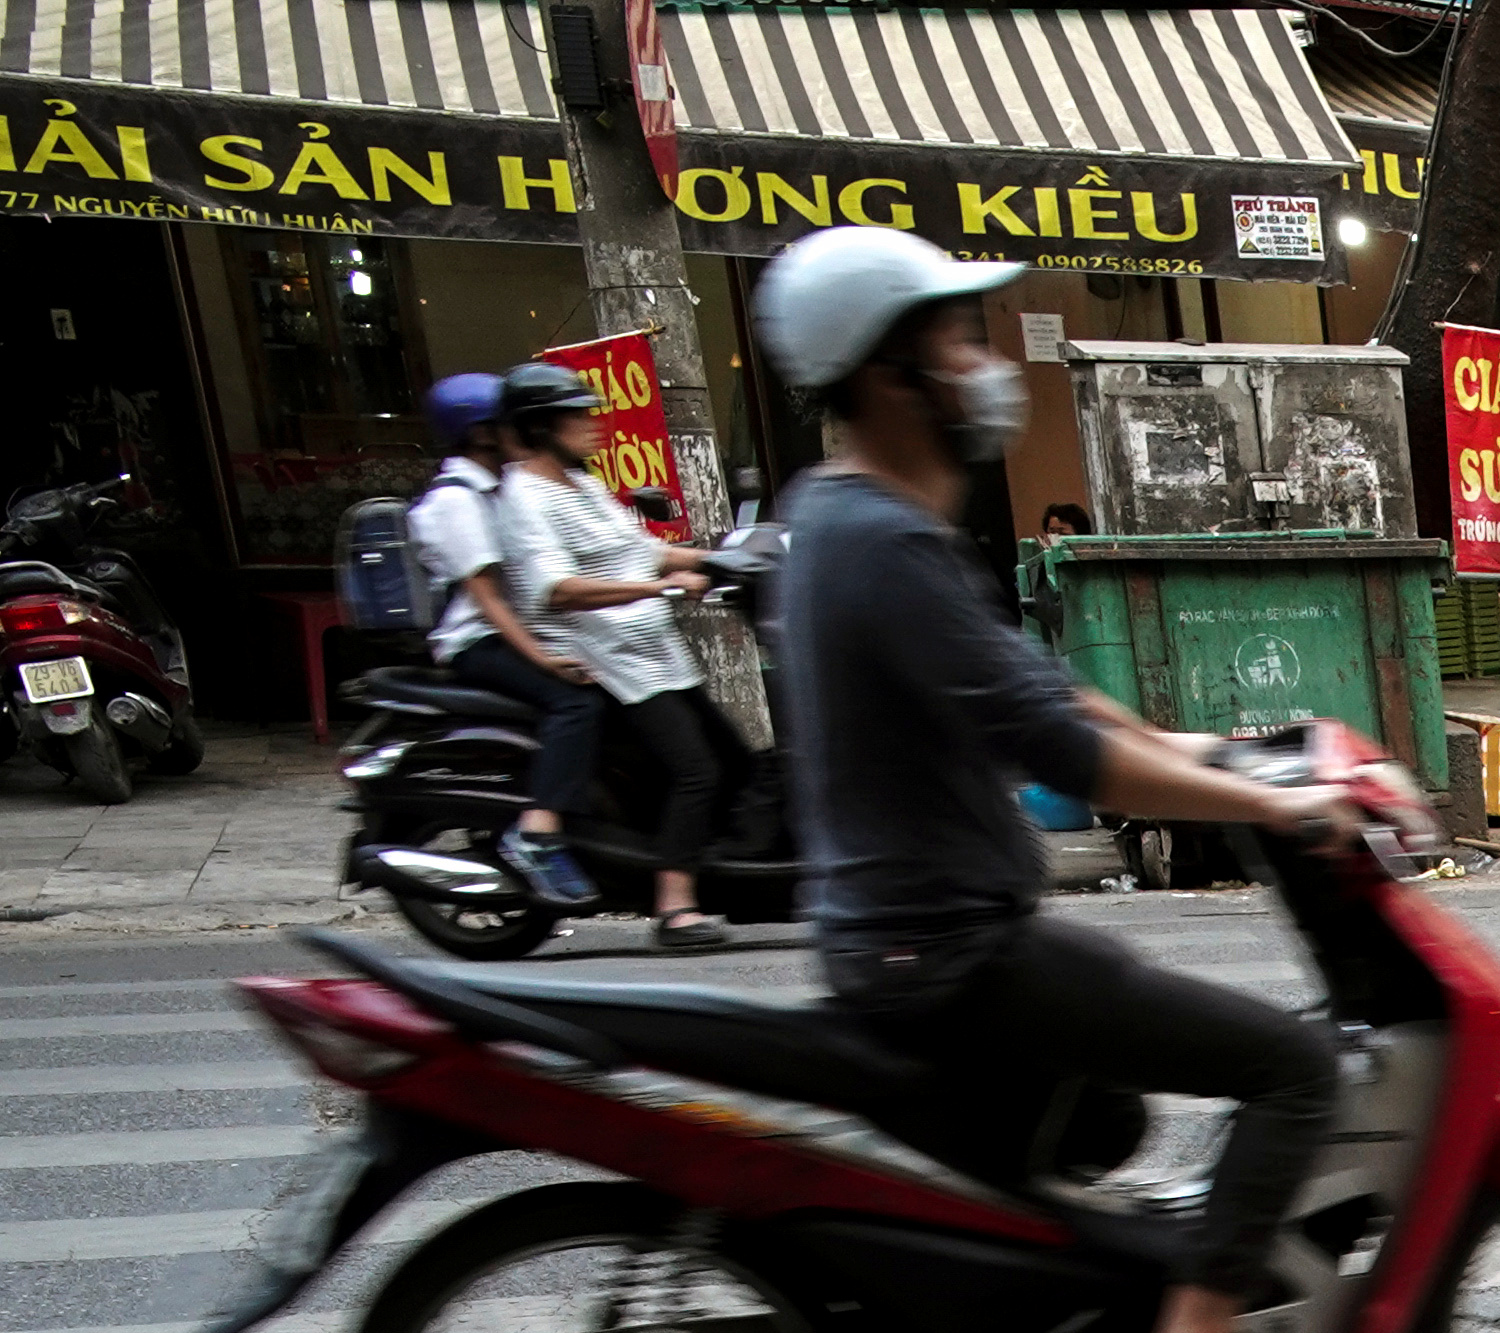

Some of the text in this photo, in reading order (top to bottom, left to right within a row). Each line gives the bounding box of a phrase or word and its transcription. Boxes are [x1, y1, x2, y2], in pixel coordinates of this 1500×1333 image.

[54, 194, 188, 220] NGUYỄN
[200, 122, 452, 206] SẢN
[498, 156, 915, 229] HƠNG
[957, 165, 1199, 243] KIỀU
